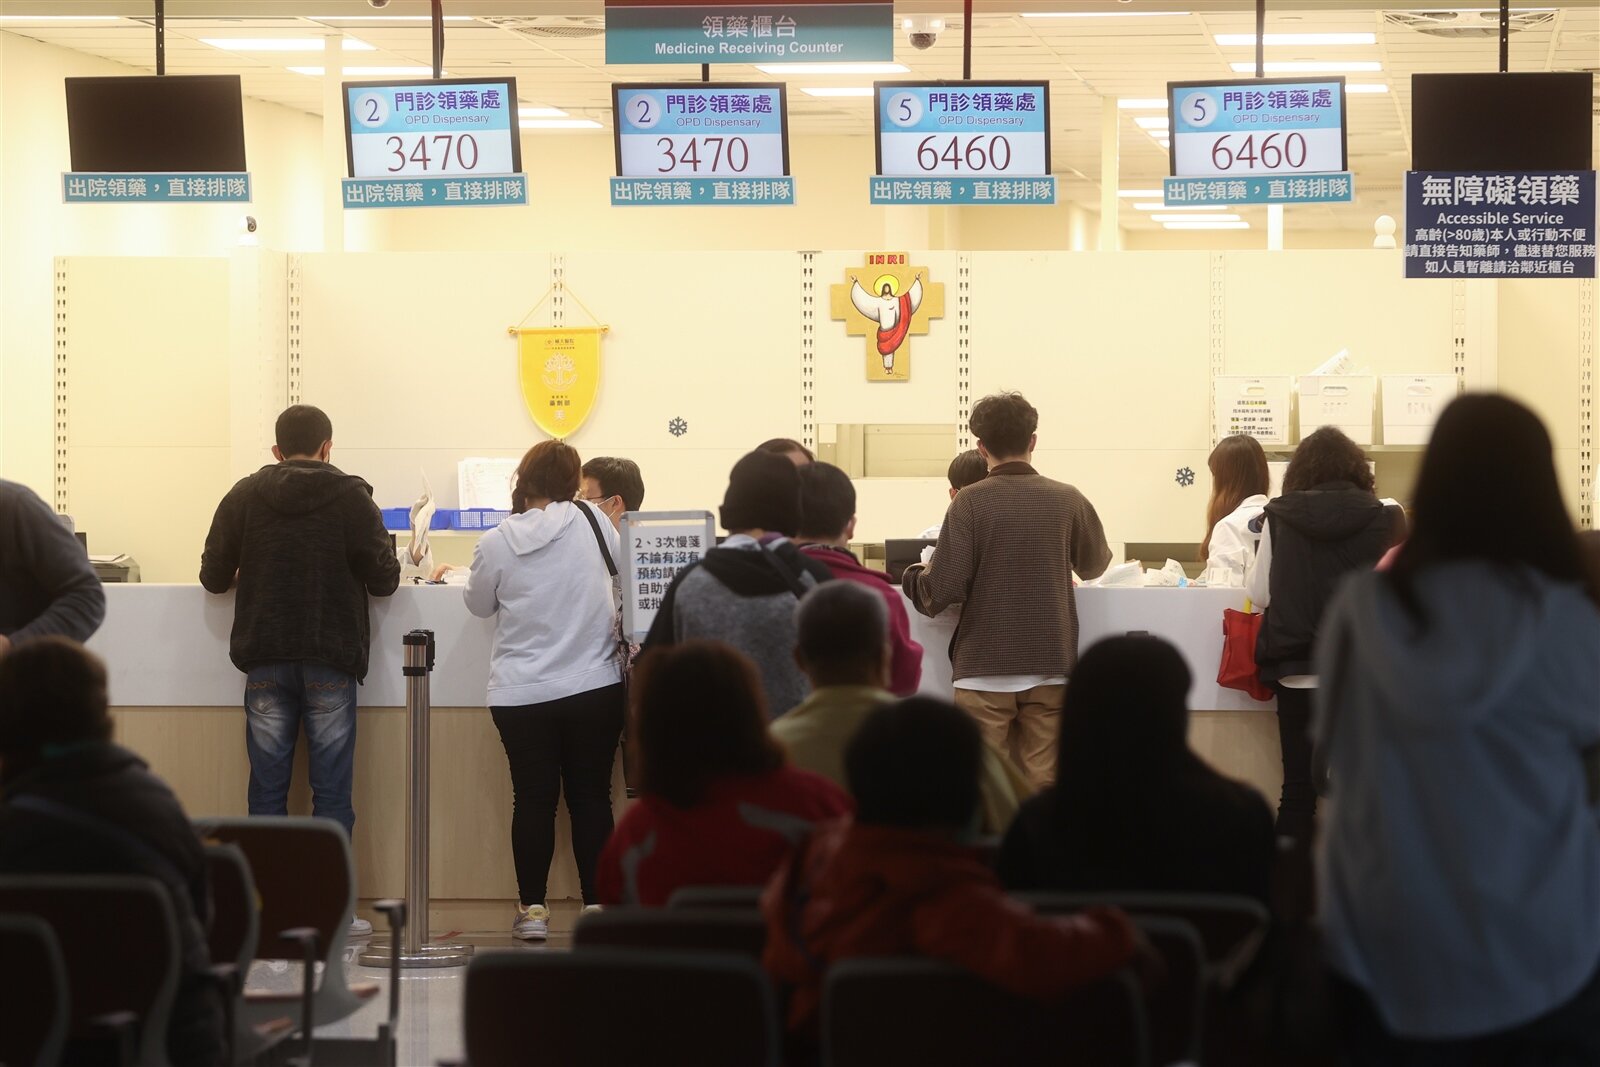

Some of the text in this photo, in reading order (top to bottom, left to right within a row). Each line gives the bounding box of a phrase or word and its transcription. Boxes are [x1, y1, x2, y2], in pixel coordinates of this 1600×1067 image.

[702, 15, 797, 38] 領藥櫃台
[655, 40, 843, 57] Medicine Receiving Counter
[366, 98, 380, 123] 2
[395, 90, 500, 112] 門診領藥處
[666, 94, 772, 115] 門診領藥處
[899, 98, 913, 122] 5
[929, 92, 1036, 113] 門診領藥處
[1193, 98, 1206, 123] 5
[1223, 89, 1332, 111] 門診領藥處
[405, 113, 490, 126] OPD Dispensary
[637, 100, 651, 123] 2
[676, 116, 761, 129] OPD Dispensary
[938, 115, 1024, 127] OPD Dispensary
[1233, 112, 1320, 125] OPD Dispensary
[386, 133, 479, 172] 3470
[657, 136, 749, 173] 3470
[917, 135, 1011, 171] 6460
[1211, 132, 1306, 170] 6460
[69, 177, 246, 198] 出院領藥，直接排隊
[346, 180, 523, 203] 出院領藥，直接排隊
[614, 180, 791, 201] 出院領藥，直接排隊
[874, 180, 1052, 201] 出院領藥，直接排隊
[1167, 178, 1349, 201] 出院領藥，直接排隊
[1422, 175, 1579, 205] 無障礙領藥
[1437, 212, 1564, 224] Accessible Service
[870, 255, 904, 264] INRI
[637, 551, 700, 564] 不論有沒有
